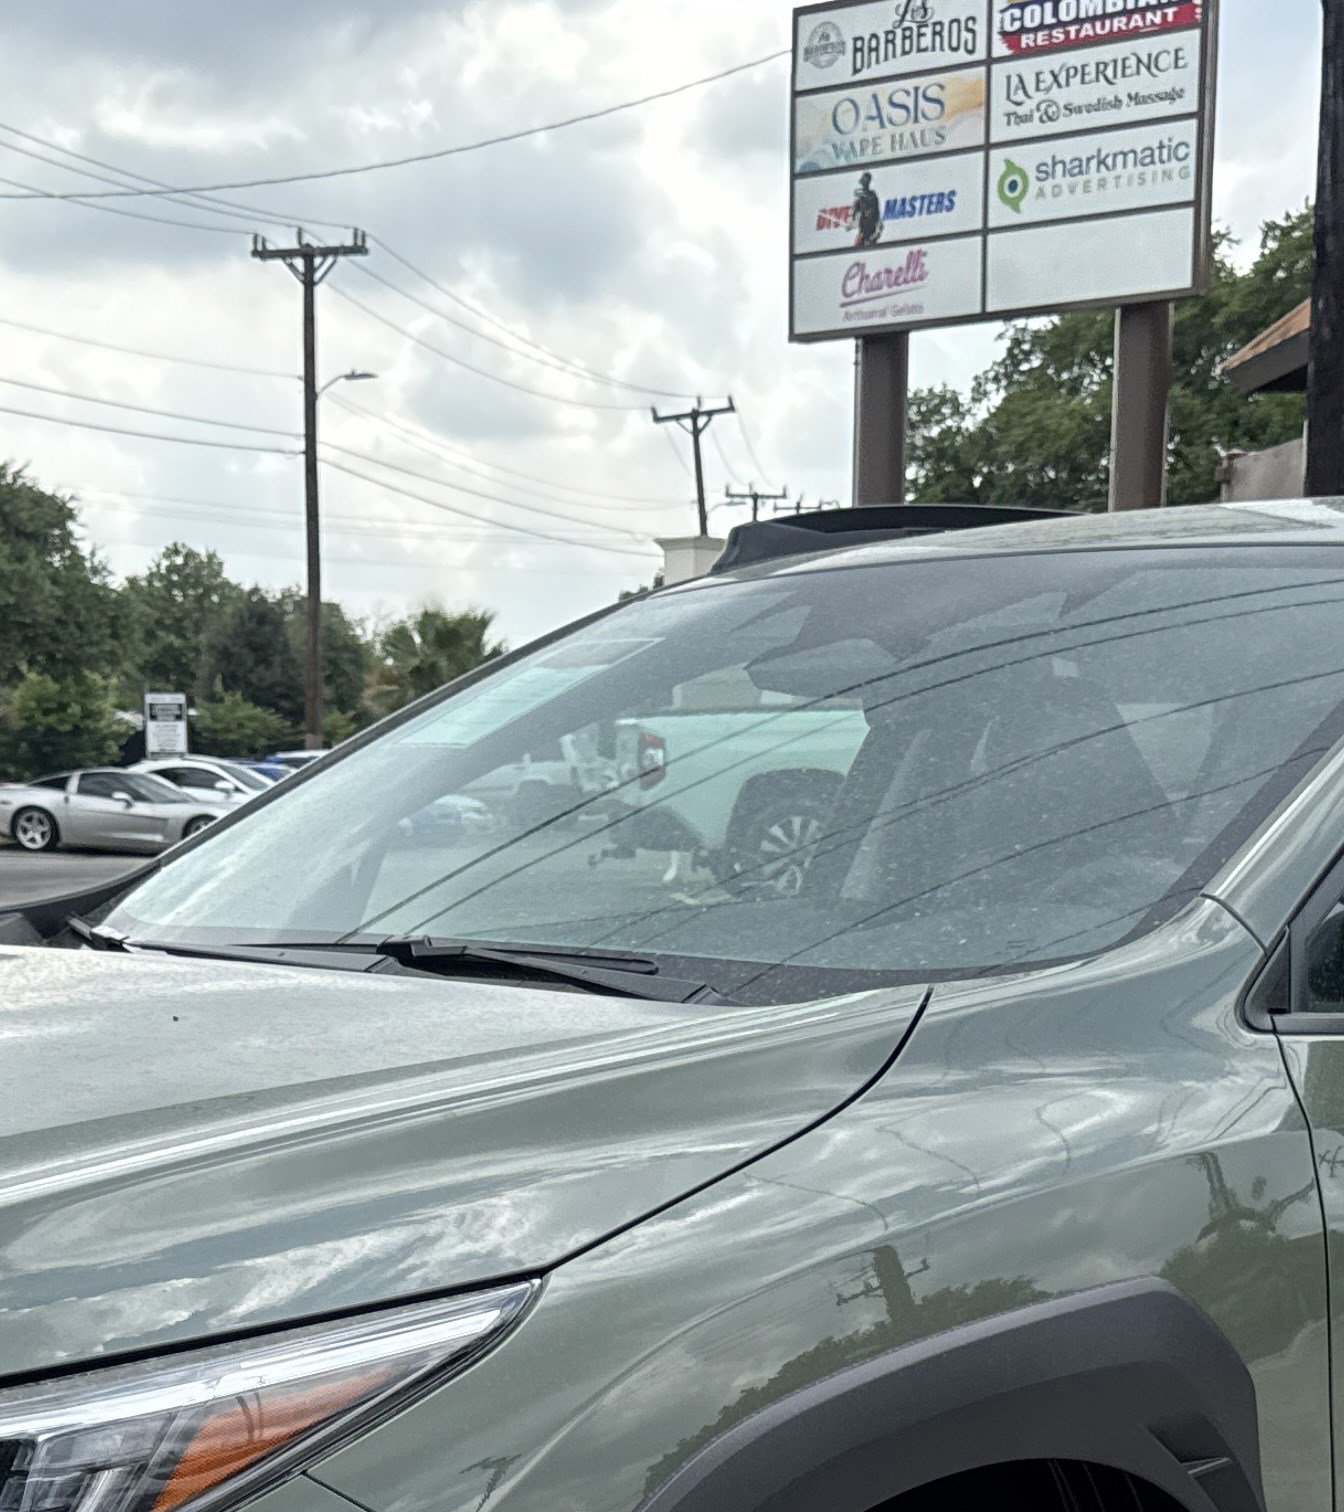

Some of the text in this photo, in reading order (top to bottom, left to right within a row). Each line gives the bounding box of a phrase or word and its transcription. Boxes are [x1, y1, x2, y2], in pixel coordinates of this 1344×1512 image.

[851, 16, 977, 76] BARBEROS
[1021, 7, 1179, 48] RESTAURANT
[1005, 48, 1189, 106] LA EXPERIENCE
[832, 82, 945, 135] OASIS
[1062, 95, 1123, 117] Swedish
[1126, 87, 1186, 108] Massage
[891, 126, 946, 152] HAUS
[1035, 137, 1191, 182] sharkmatic
[1035, 165, 1191, 200] ADVERTISING
[882, 189, 956, 221] MASTERS
